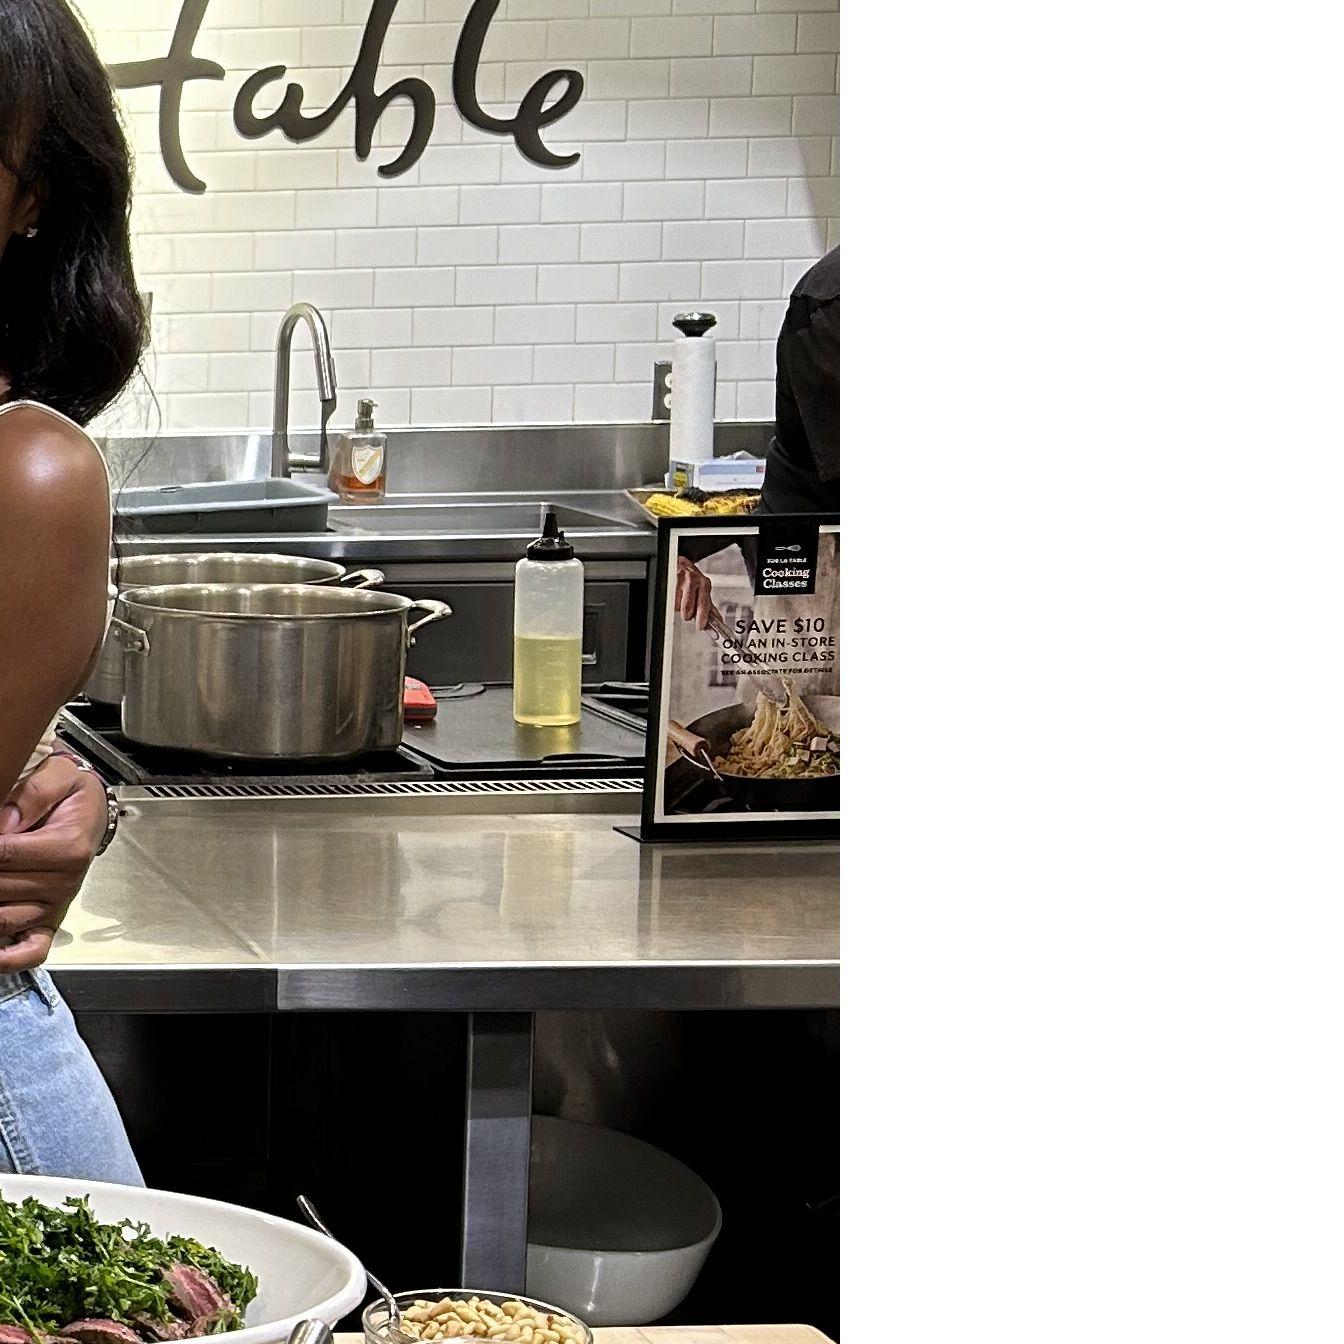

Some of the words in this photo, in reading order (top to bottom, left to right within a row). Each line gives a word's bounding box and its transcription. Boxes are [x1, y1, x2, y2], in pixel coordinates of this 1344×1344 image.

[762, 566, 810, 578] Cooking
[763, 578, 808, 588] Classes
[735, 618, 787, 634] SAVE
[793, 617, 825, 634] $10
[722, 638, 743, 649] ON
[747, 638, 767, 649] AN
[772, 636, 835, 648] IN-STORE
[721, 652, 788, 664] COOKING
[792, 651, 835, 662] CLASS
